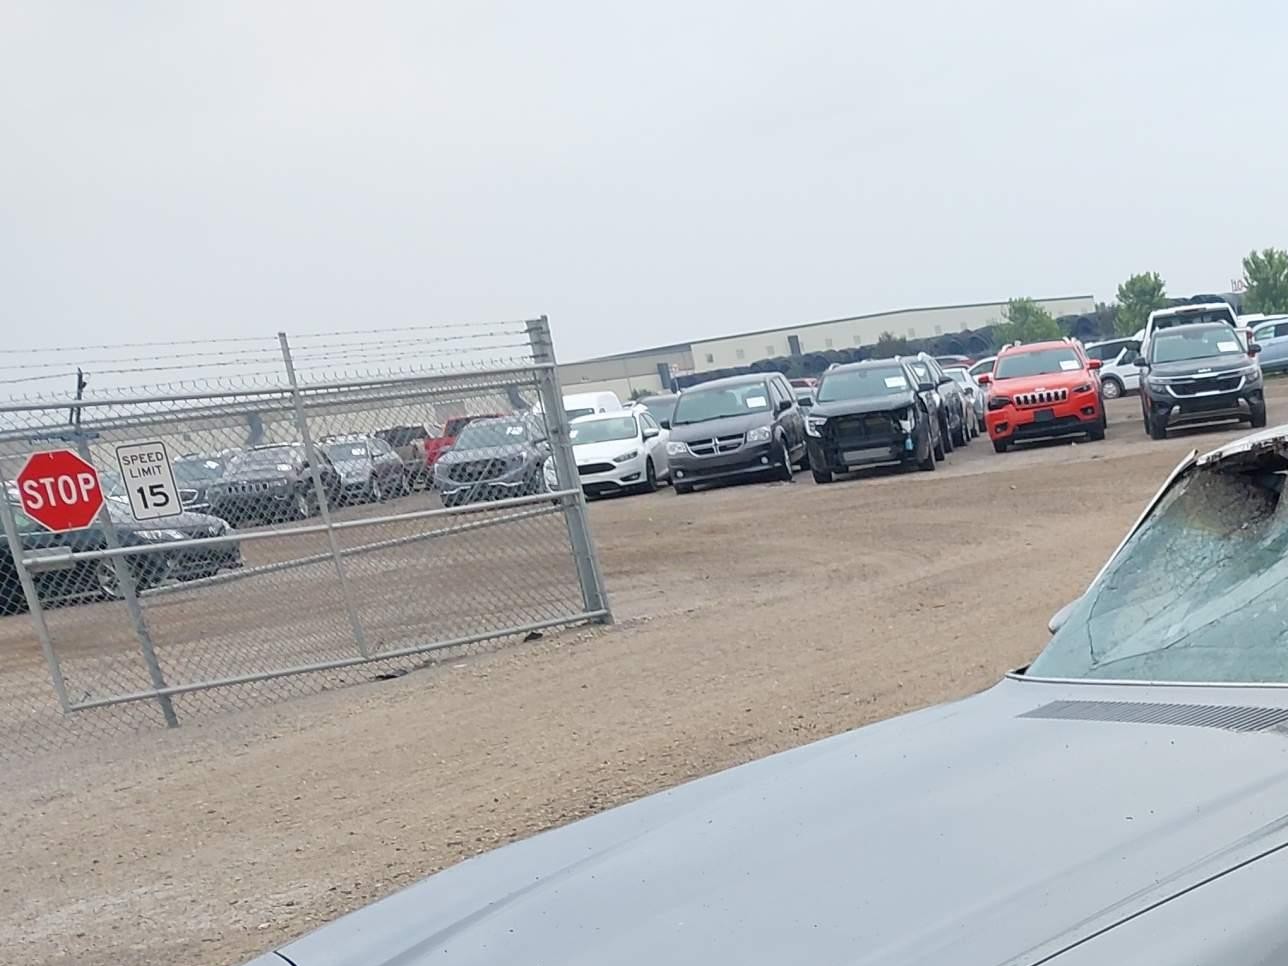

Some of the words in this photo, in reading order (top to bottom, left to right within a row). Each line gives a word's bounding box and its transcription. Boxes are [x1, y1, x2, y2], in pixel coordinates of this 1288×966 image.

[122, 452, 164, 466] SPEED
[130, 465, 162, 479] LIMIT
[23, 473, 95, 509] STOP
[136, 484, 169, 509] 15
